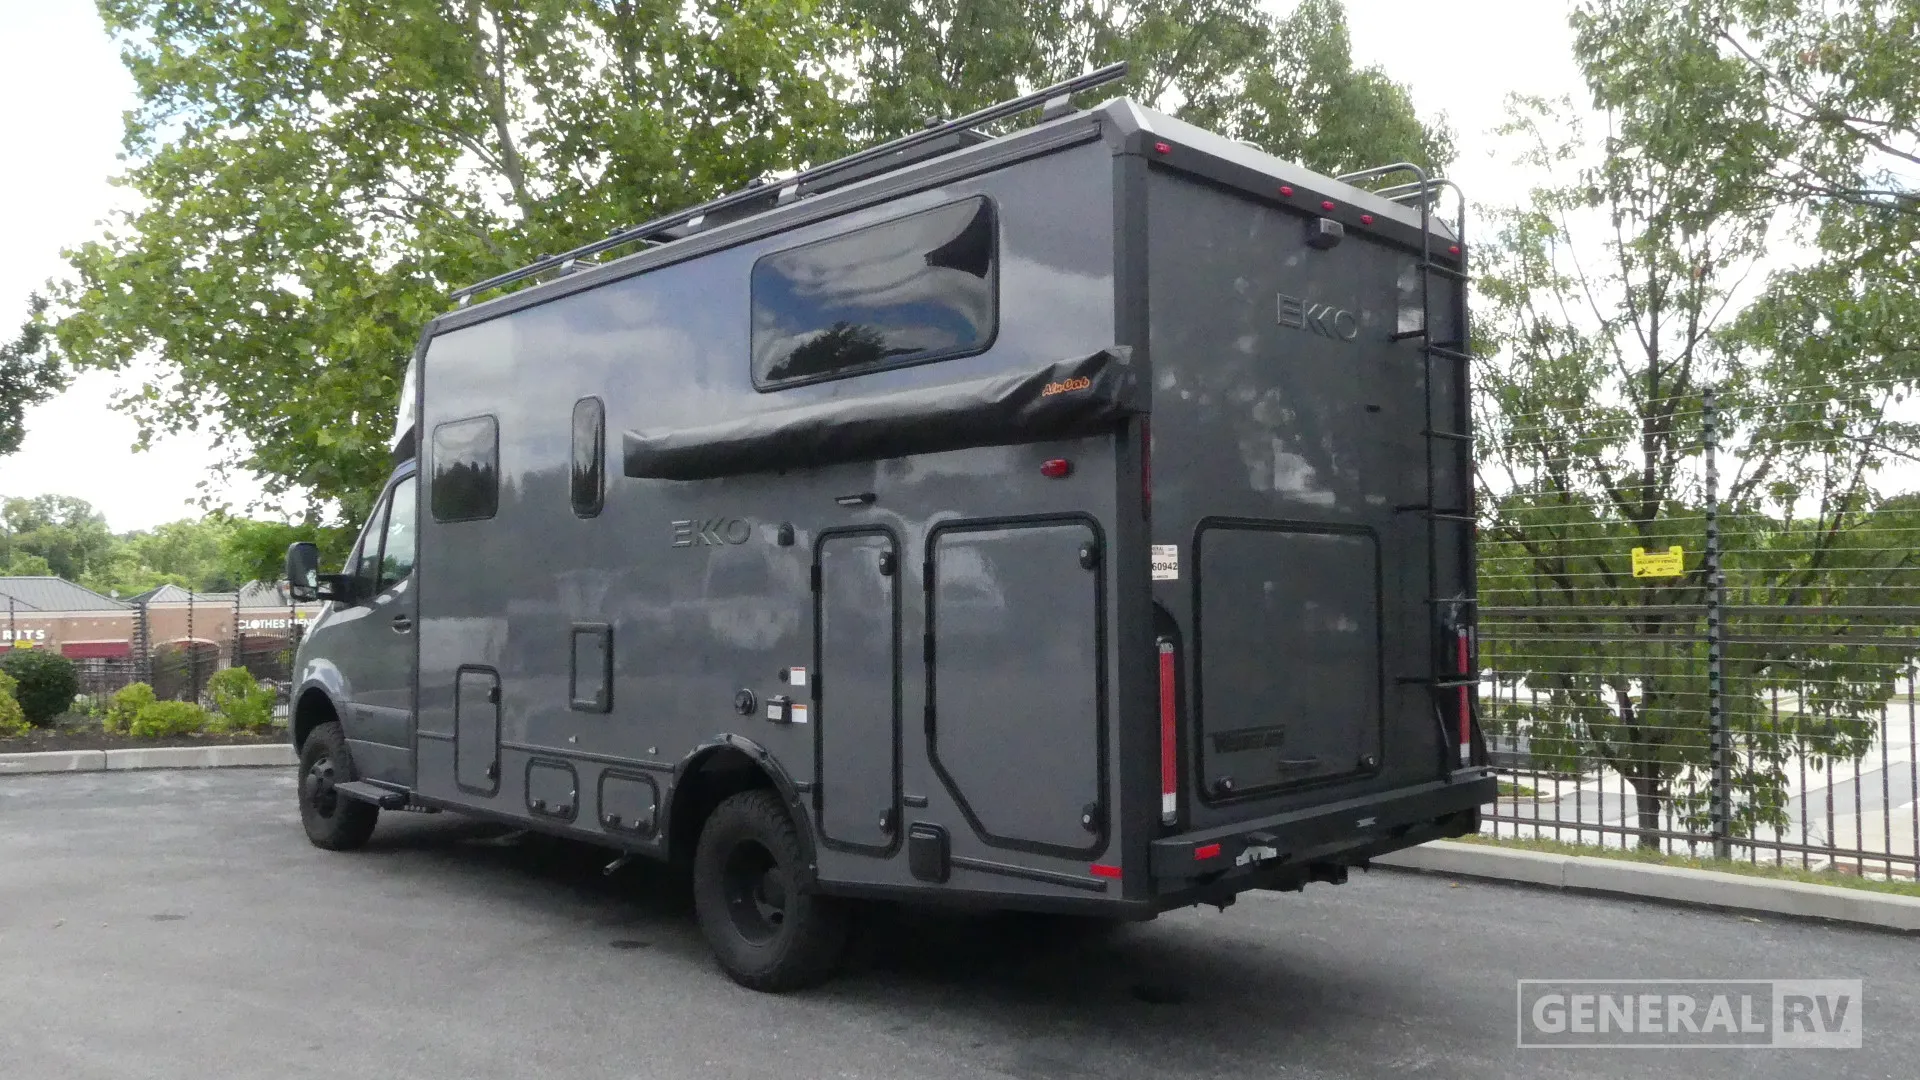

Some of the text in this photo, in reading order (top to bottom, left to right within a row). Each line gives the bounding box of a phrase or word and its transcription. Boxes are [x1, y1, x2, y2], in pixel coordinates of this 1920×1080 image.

[1277, 293, 1357, 342] EKKO
[671, 517, 751, 548] EKKO
[1152, 561, 1177, 571] 60942
[238, 618, 285, 629] CLOTHES
[2, 629, 45, 641] RITS
